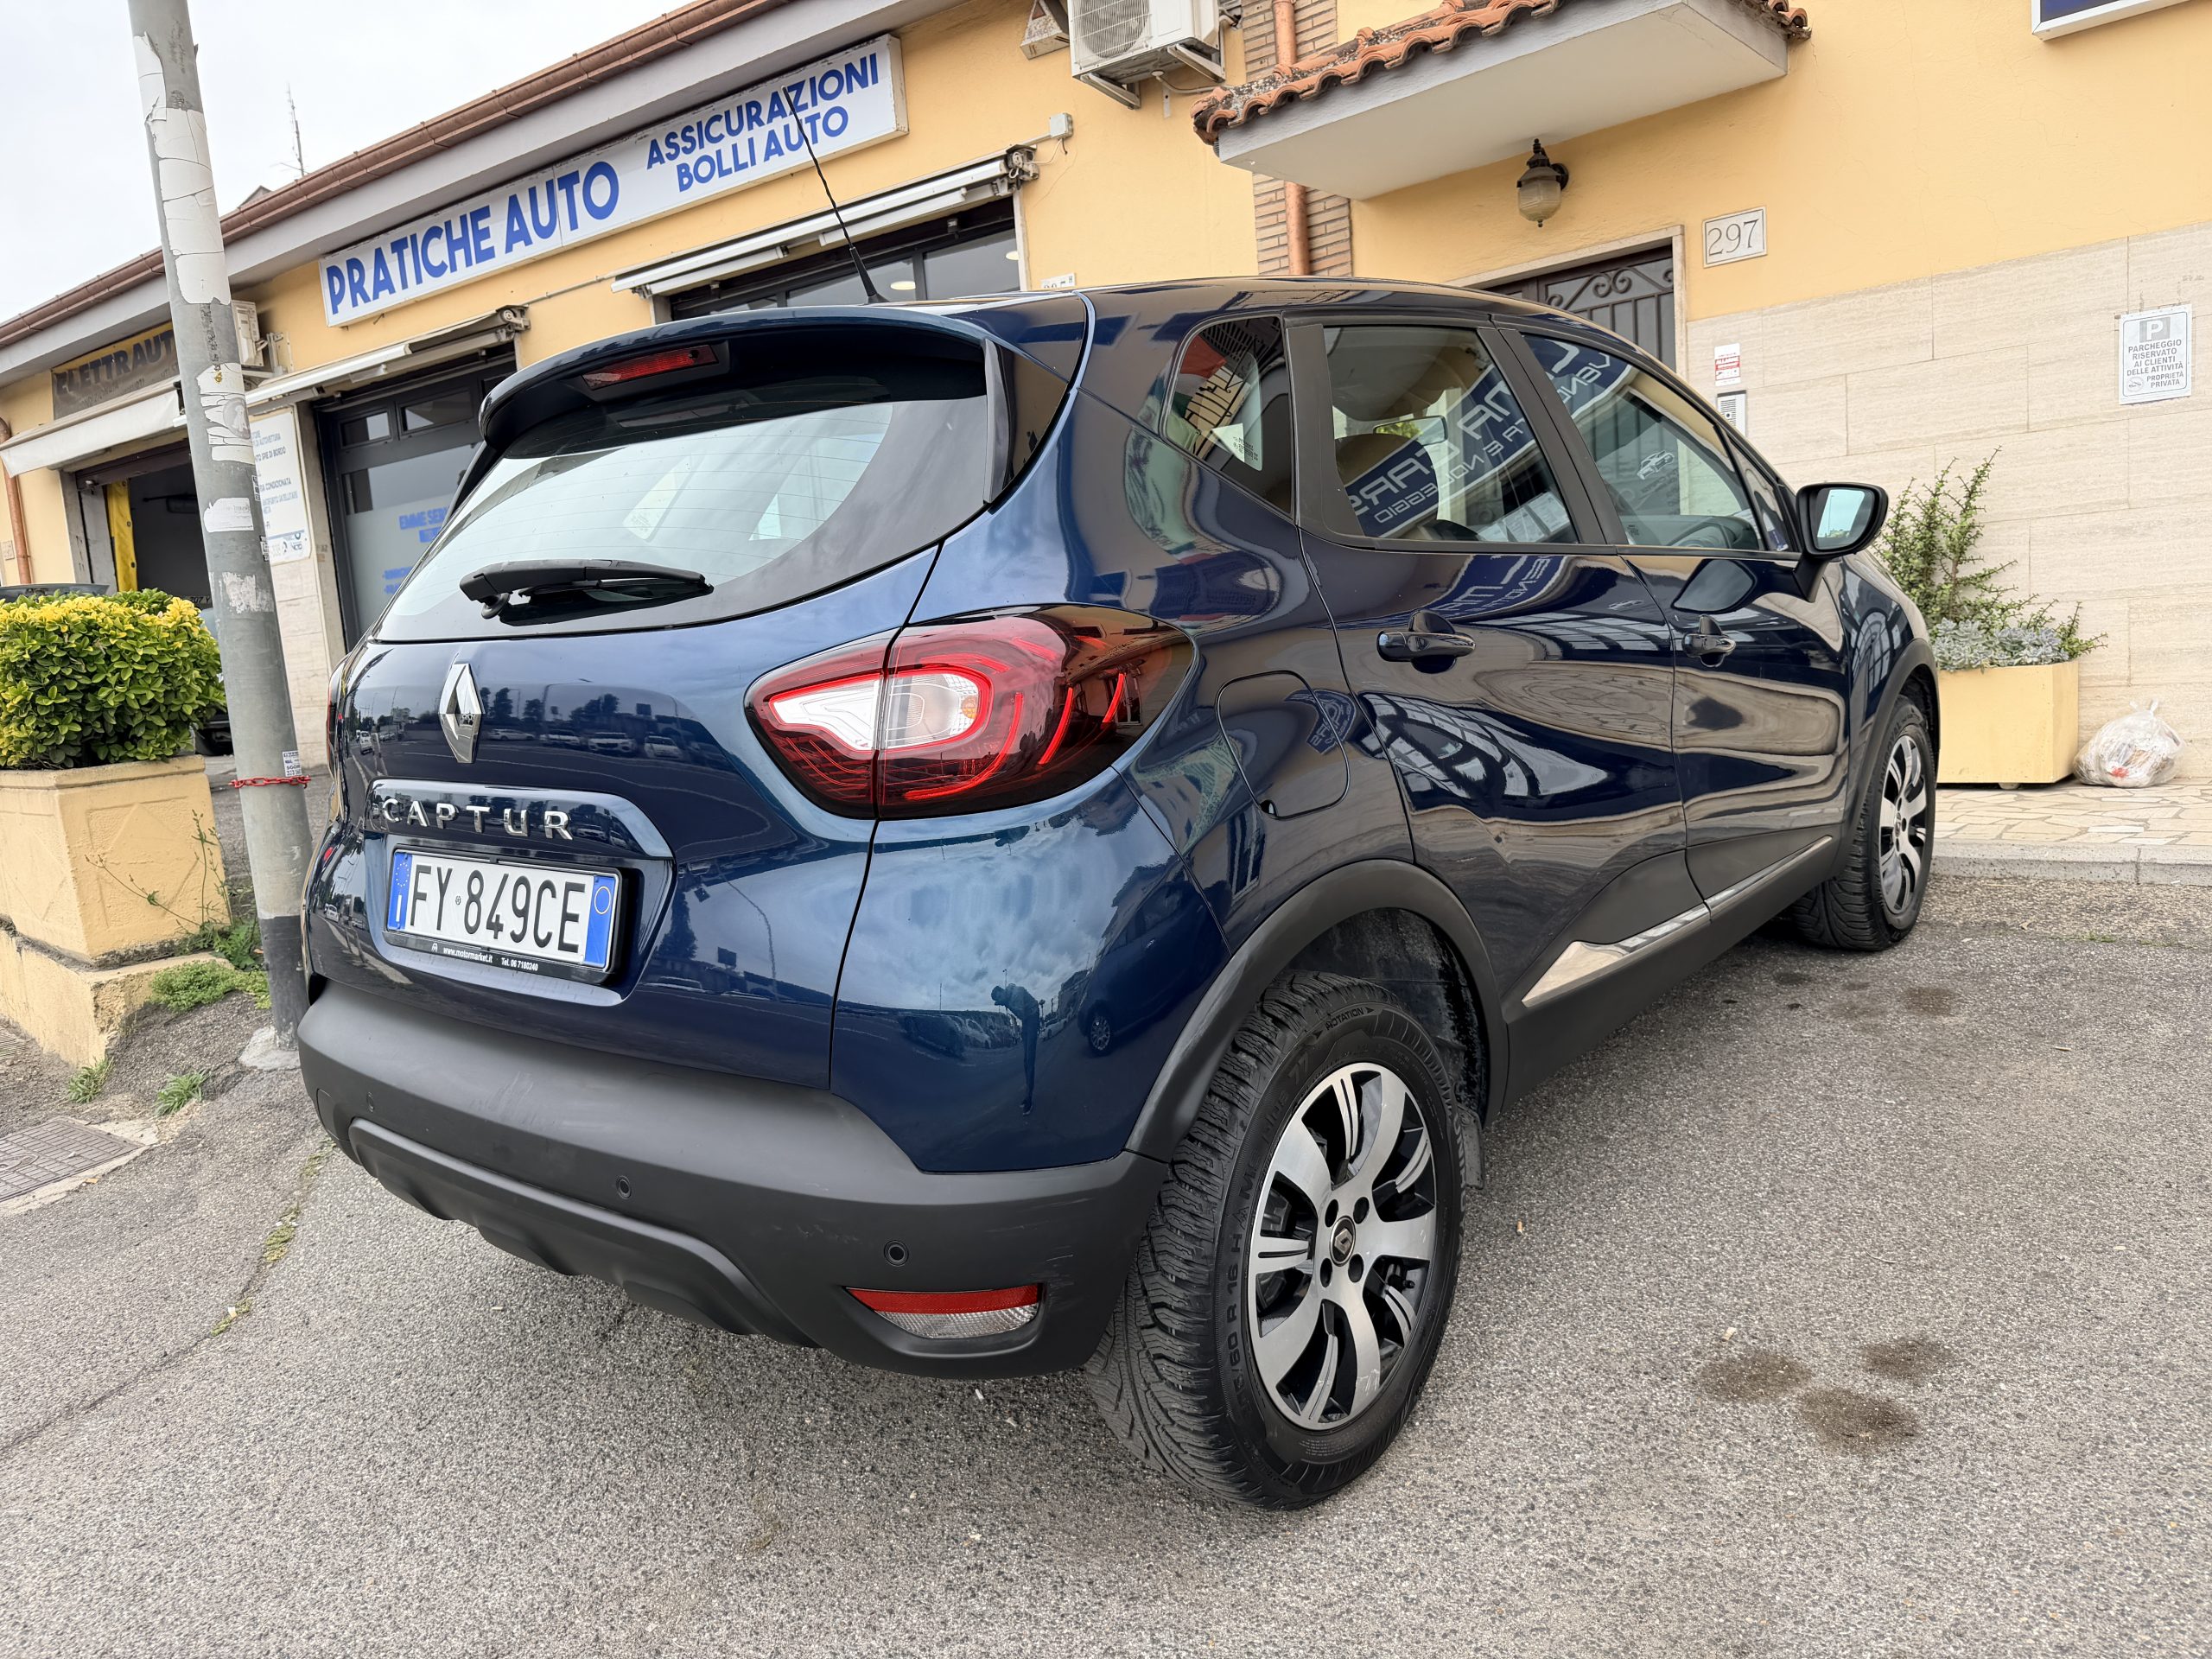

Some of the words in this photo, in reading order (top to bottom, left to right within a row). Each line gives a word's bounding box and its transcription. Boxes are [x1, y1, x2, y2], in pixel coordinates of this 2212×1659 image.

[647, 53, 879, 169] ASSICURAZIONI
[677, 137, 757, 193] BOLLI
[763, 105, 849, 163] AUTO
[327, 205, 496, 315] PRATICHE
[505, 161, 620, 256] AUTO
[1708, 219, 1759, 257] 297
[2145, 319, 2164, 341] P
[2128, 339, 2182, 353] PARCHEGGIO
[2133, 347, 2177, 361] RISERVATO
[54, 328, 176, 397] ELETTRAUT
[2126, 366, 2149, 376] DELLE
[2151, 361, 2183, 373] ATTIVITÀ
[2145, 356, 2176, 366] CLIENTI
[2146, 371, 2183, 382] PROPRIETÀ
[2151, 378, 2180, 388] PRIVATA
[383, 798, 573, 841] CAPTUR
[443, 947, 493, 963] www.motormarket.it
[511, 959, 518, 968] 06
[1325, 1007, 1365, 1031] ROTATION
